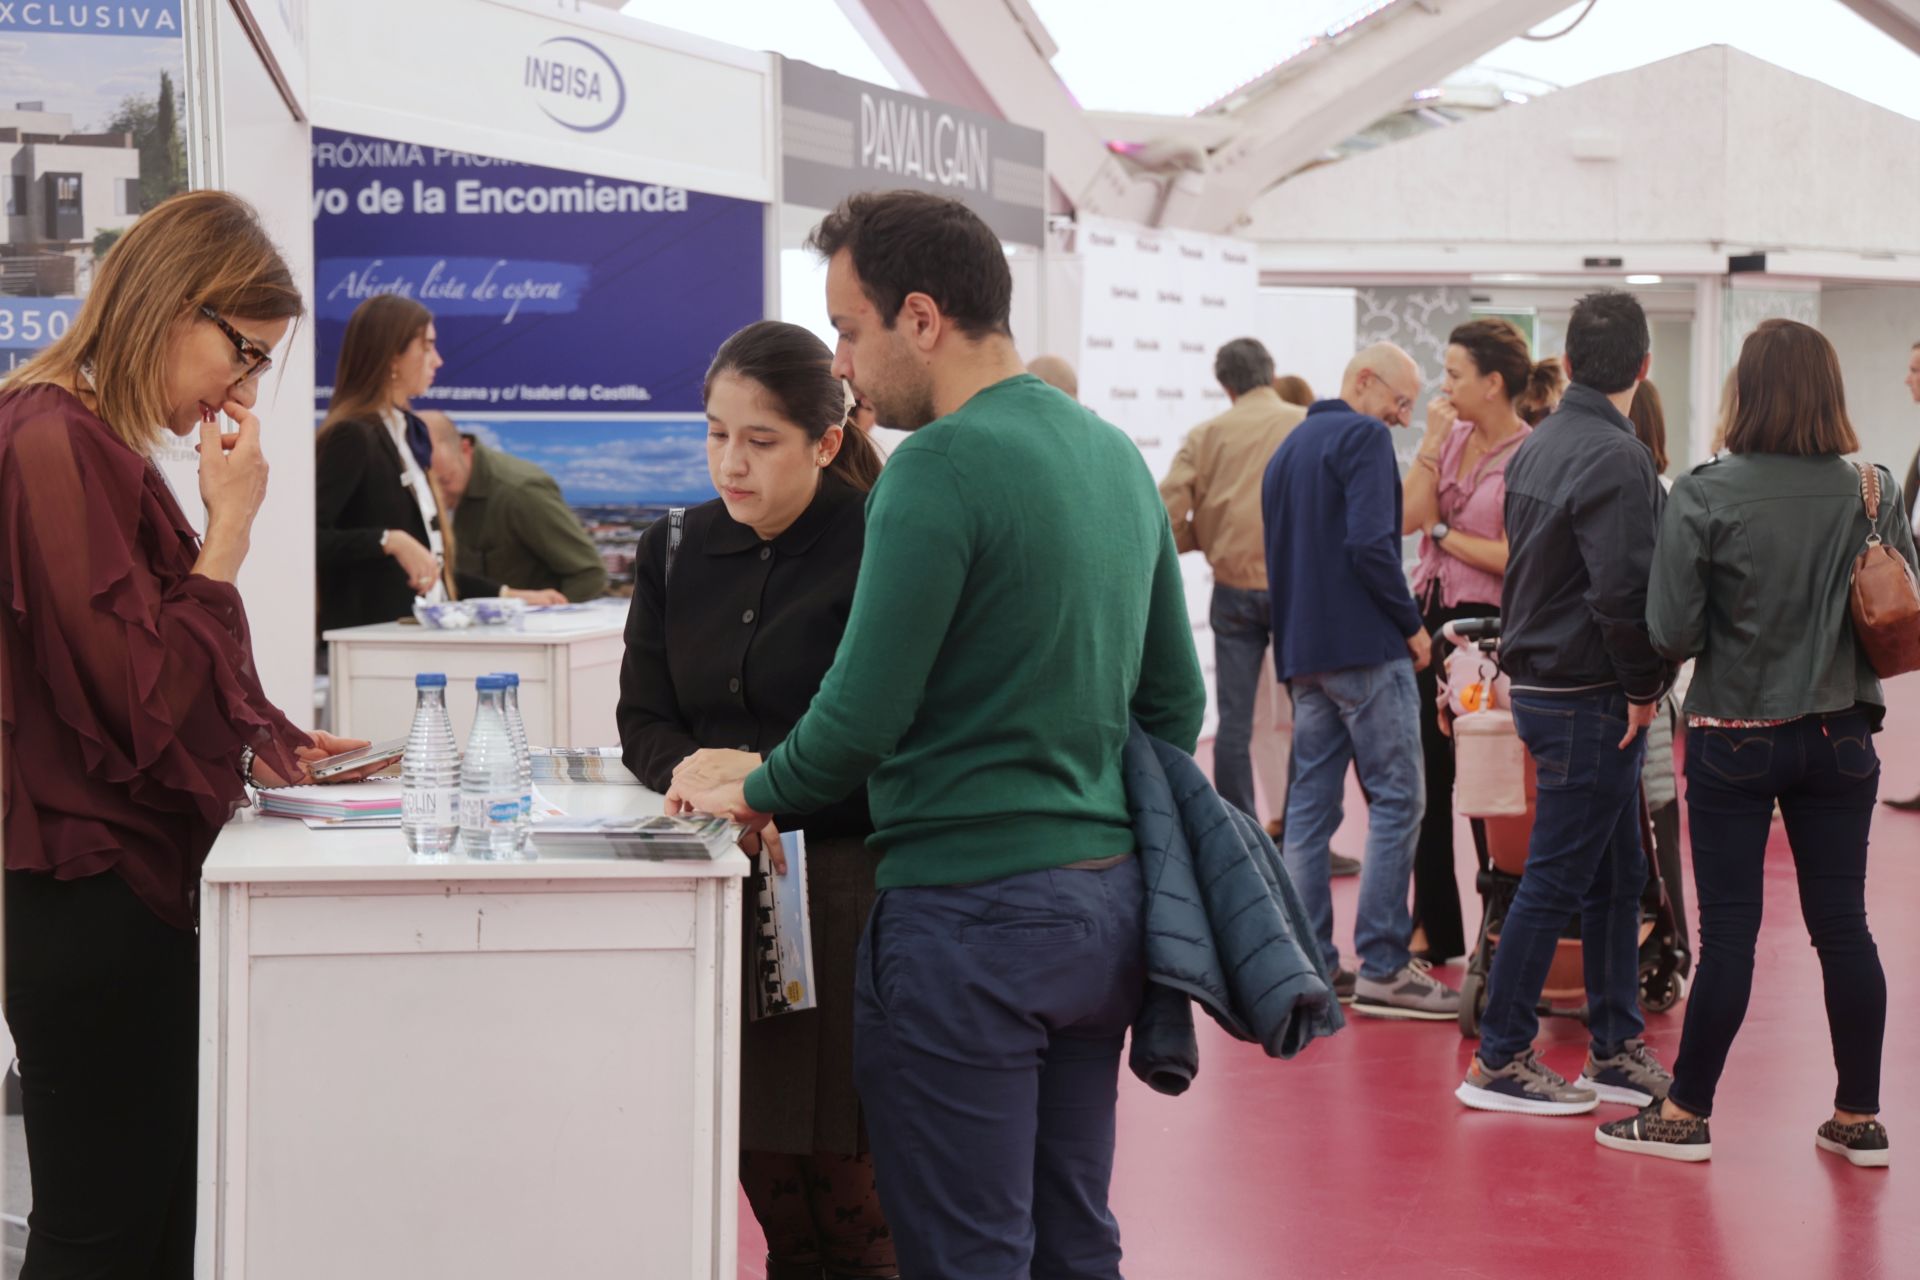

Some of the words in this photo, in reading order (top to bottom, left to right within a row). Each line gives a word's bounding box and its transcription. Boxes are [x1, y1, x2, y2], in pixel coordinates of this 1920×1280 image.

[523, 55, 603, 103] INBISA
[860, 91, 989, 194] PAVALGAN
[356, 179, 404, 215] de
[412, 178, 446, 214] la
[455, 177, 689, 215] Encomienda
[327, 258, 413, 300] Abierta
[420, 258, 467, 299] lista
[471, 258, 508, 301] de
[502, 278, 564, 325] espera
[489, 387, 500, 403] y
[519, 384, 566, 401] Isabel
[567, 384, 589, 401] de
